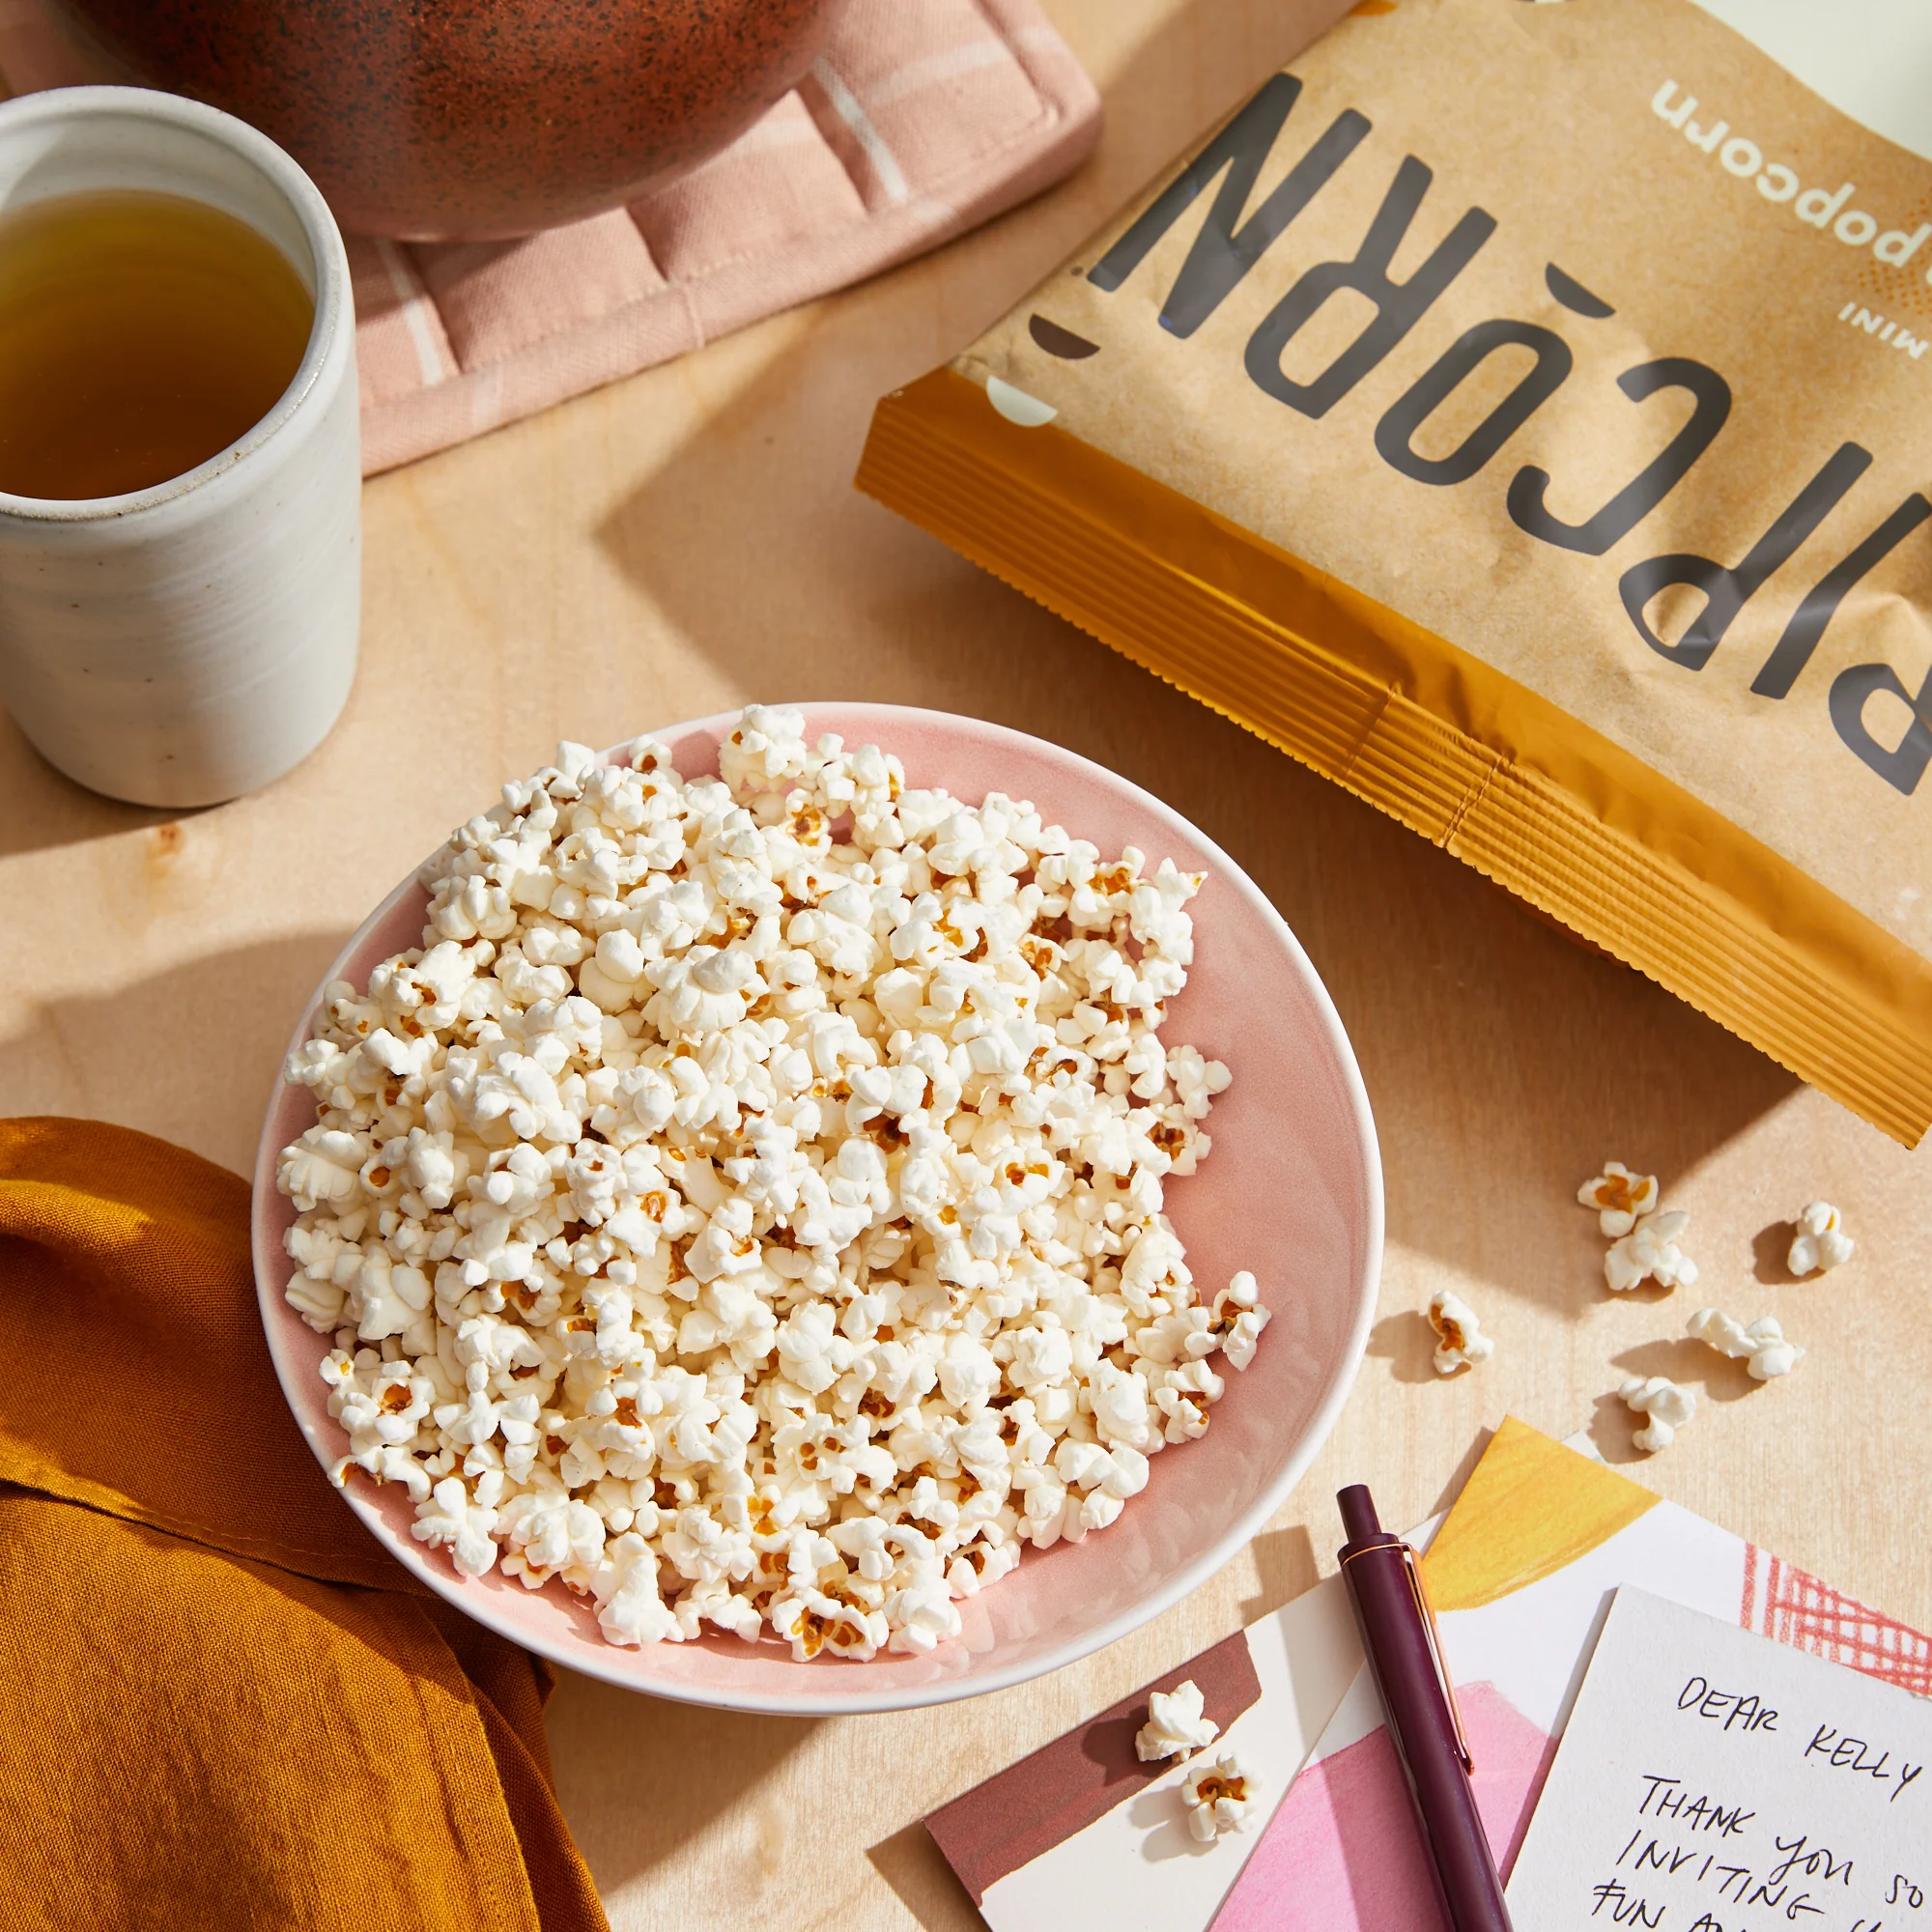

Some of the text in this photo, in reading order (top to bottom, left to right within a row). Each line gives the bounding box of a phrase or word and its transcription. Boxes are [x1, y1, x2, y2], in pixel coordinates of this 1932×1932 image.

[1651, 78, 1932, 268] popcorn
[1837, 301, 1930, 359] MINI
[1677, 1677, 1923, 1802] DEAR KELLY
[1639, 1775, 1756, 1837] THANK
[1592, 1878, 1666, 1929] FUN
[1616, 1829, 1826, 1920] INVITING
